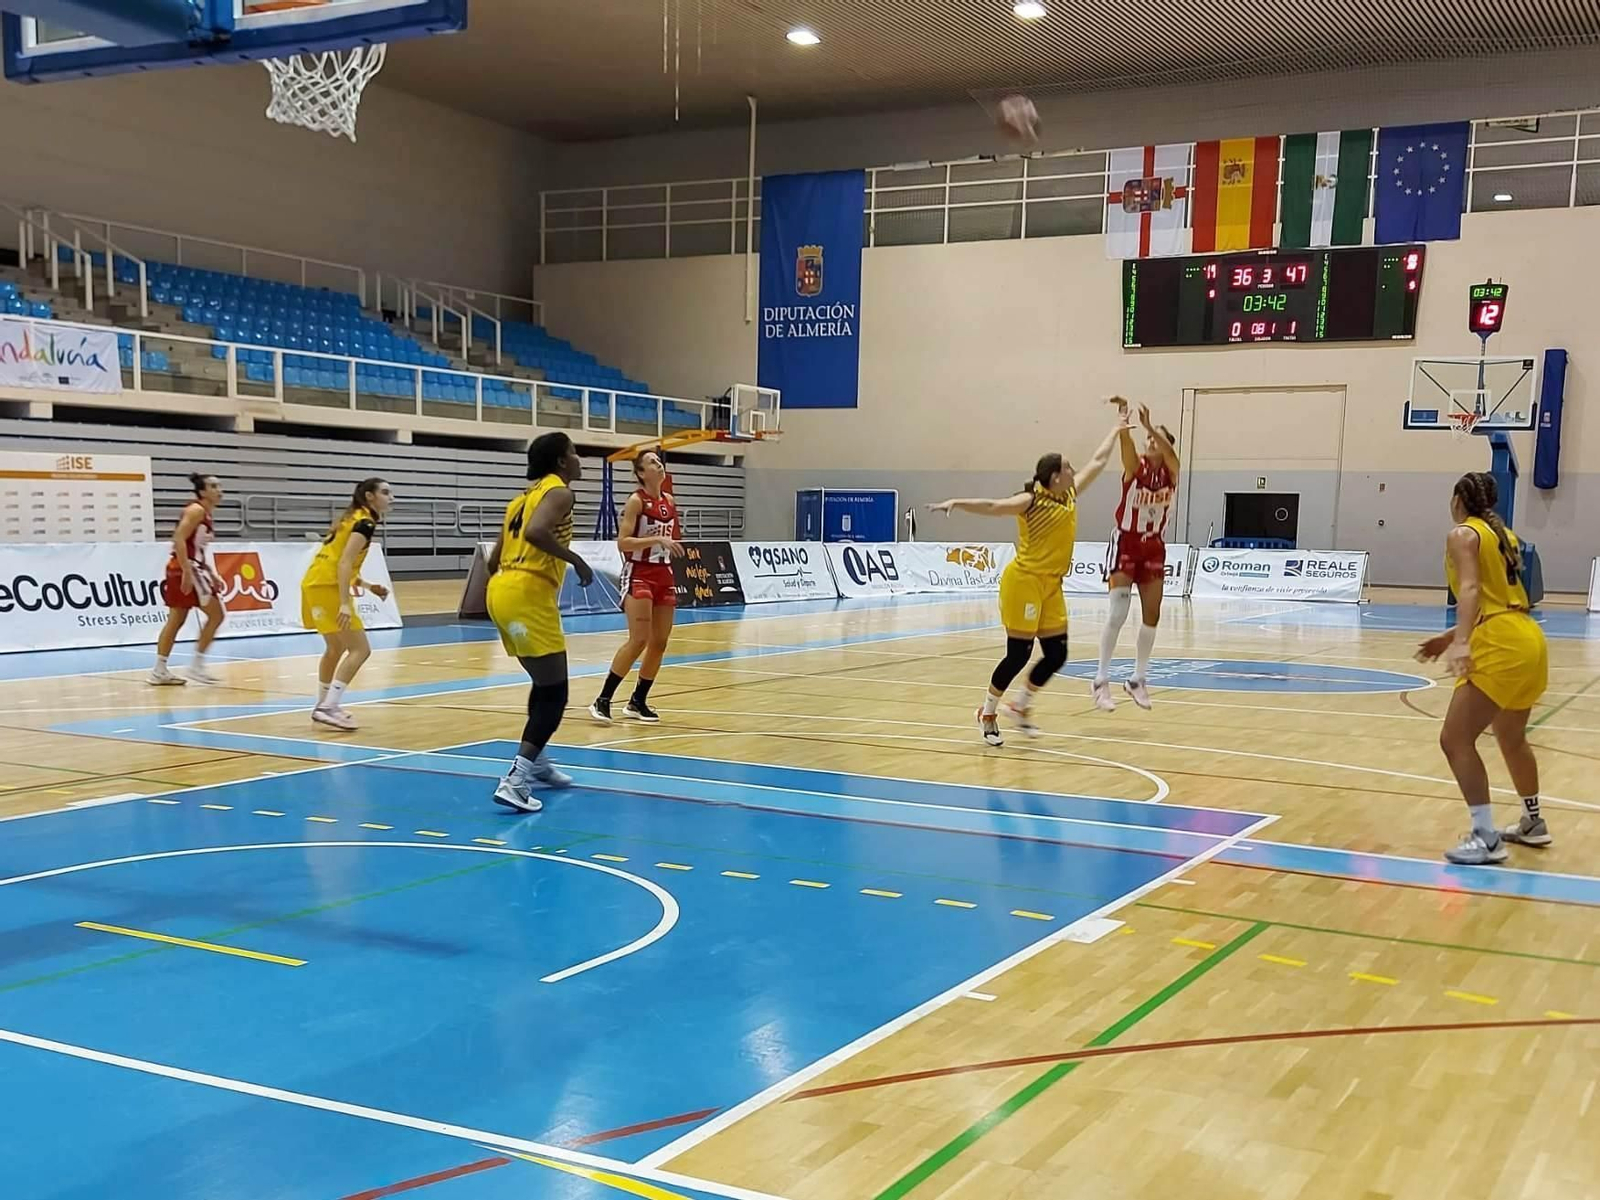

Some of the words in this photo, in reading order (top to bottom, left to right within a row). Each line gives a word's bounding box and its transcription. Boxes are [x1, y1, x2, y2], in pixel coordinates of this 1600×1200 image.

[1232, 268, 1253, 286] 36
[1262, 268, 1272, 283] 3
[1286, 265, 1307, 282] 47
[1474, 287, 1502, 297] 03:42
[1243, 294, 1287, 312] 03:42
[763, 302, 856, 322] DIPUTACIÓN
[1479, 304, 1499, 325] 12
[765, 323, 784, 339] DE
[787, 318, 853, 338] ALMERÍA
[1231, 321, 1242, 337] 0
[1290, 320, 1297, 335] 1
[0, 328, 108, 372] ndalucía
[71, 456, 94, 470] ISE
[659, 504, 668, 518] 6
[508, 503, 526, 539] 4
[1222, 560, 1271, 572] Roman
[1306, 559, 1358, 571] REALE
[928, 570, 963, 586] Divina
[1305, 570, 1357, 579] SEGUROS
[78, 614, 118, 627] Stress
